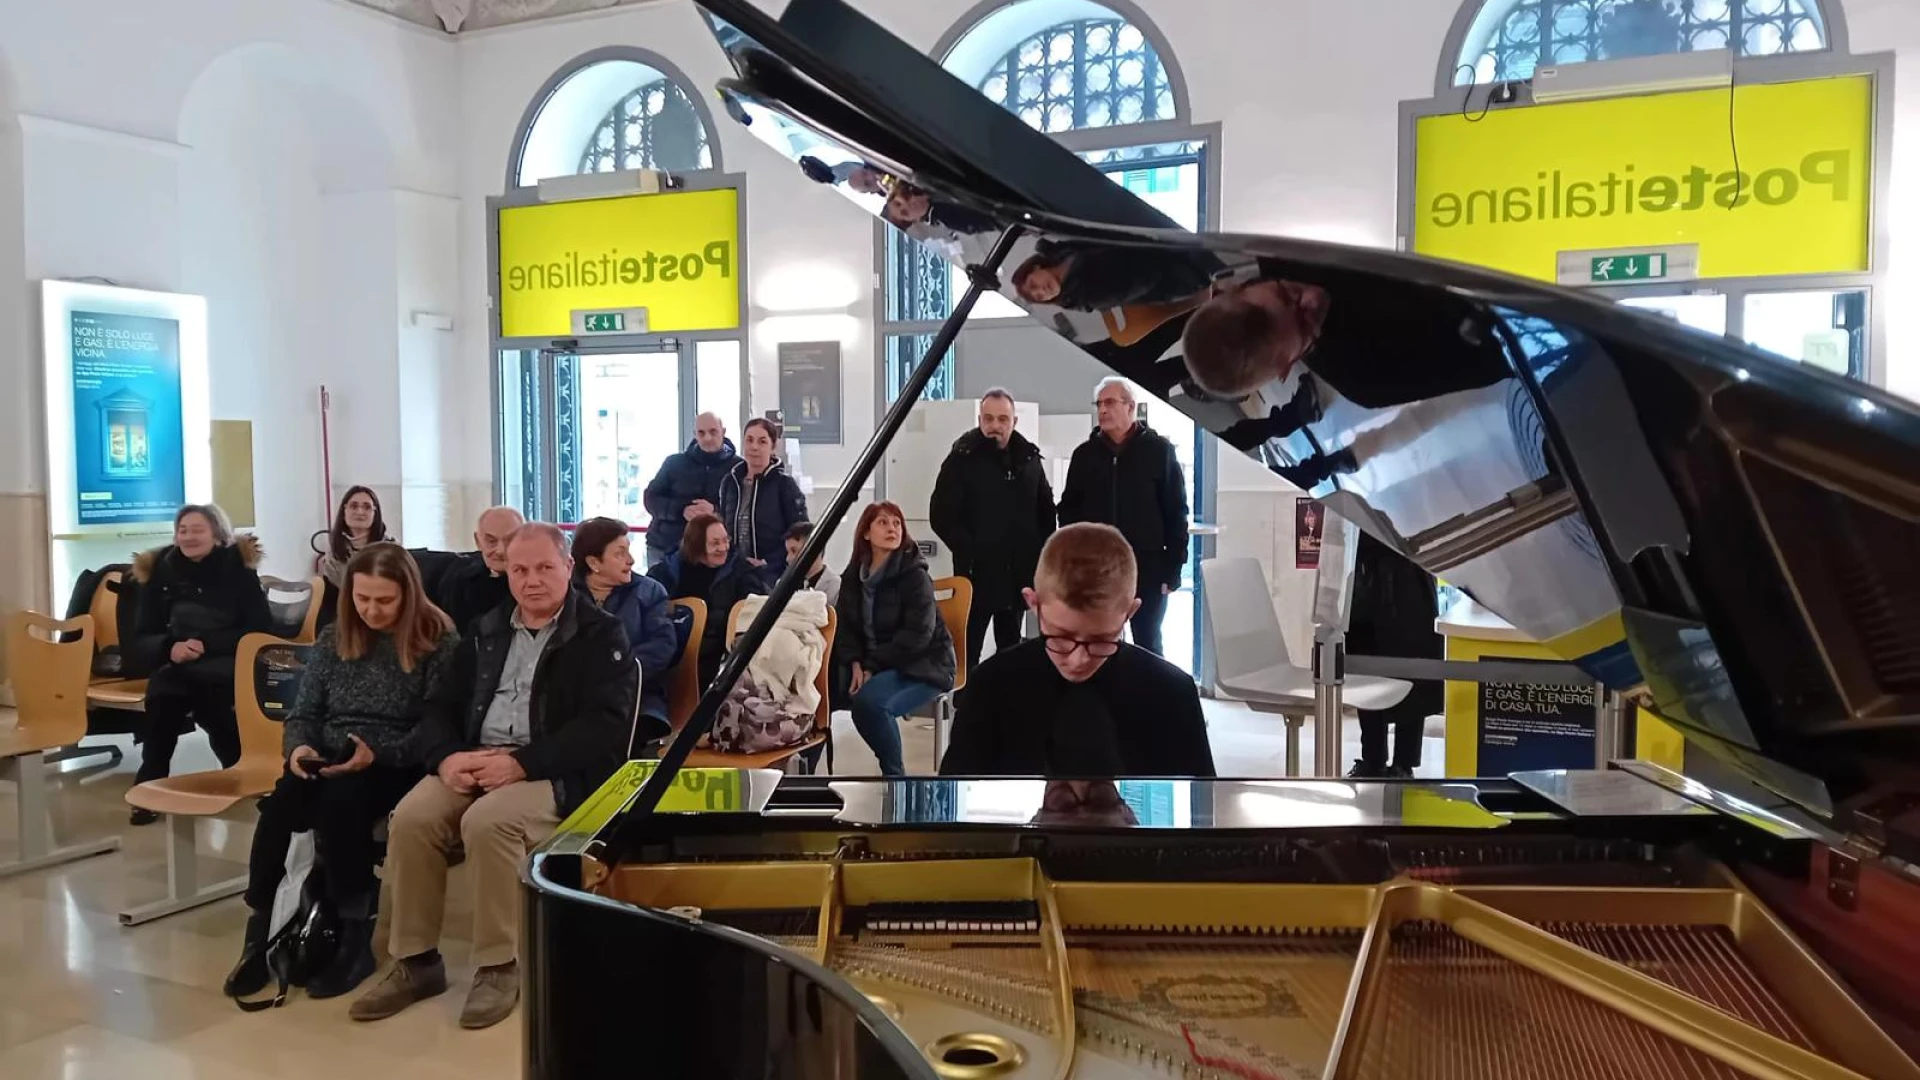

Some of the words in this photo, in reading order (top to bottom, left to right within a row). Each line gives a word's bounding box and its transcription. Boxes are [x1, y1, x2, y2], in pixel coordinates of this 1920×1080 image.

[74, 327, 96, 337] NON
[105, 329, 131, 339] SOLO
[75, 337, 81, 347] E
[1485, 688, 1494, 699] E
[1485, 700, 1497, 710] DI
[1500, 701, 1532, 714] CASA
